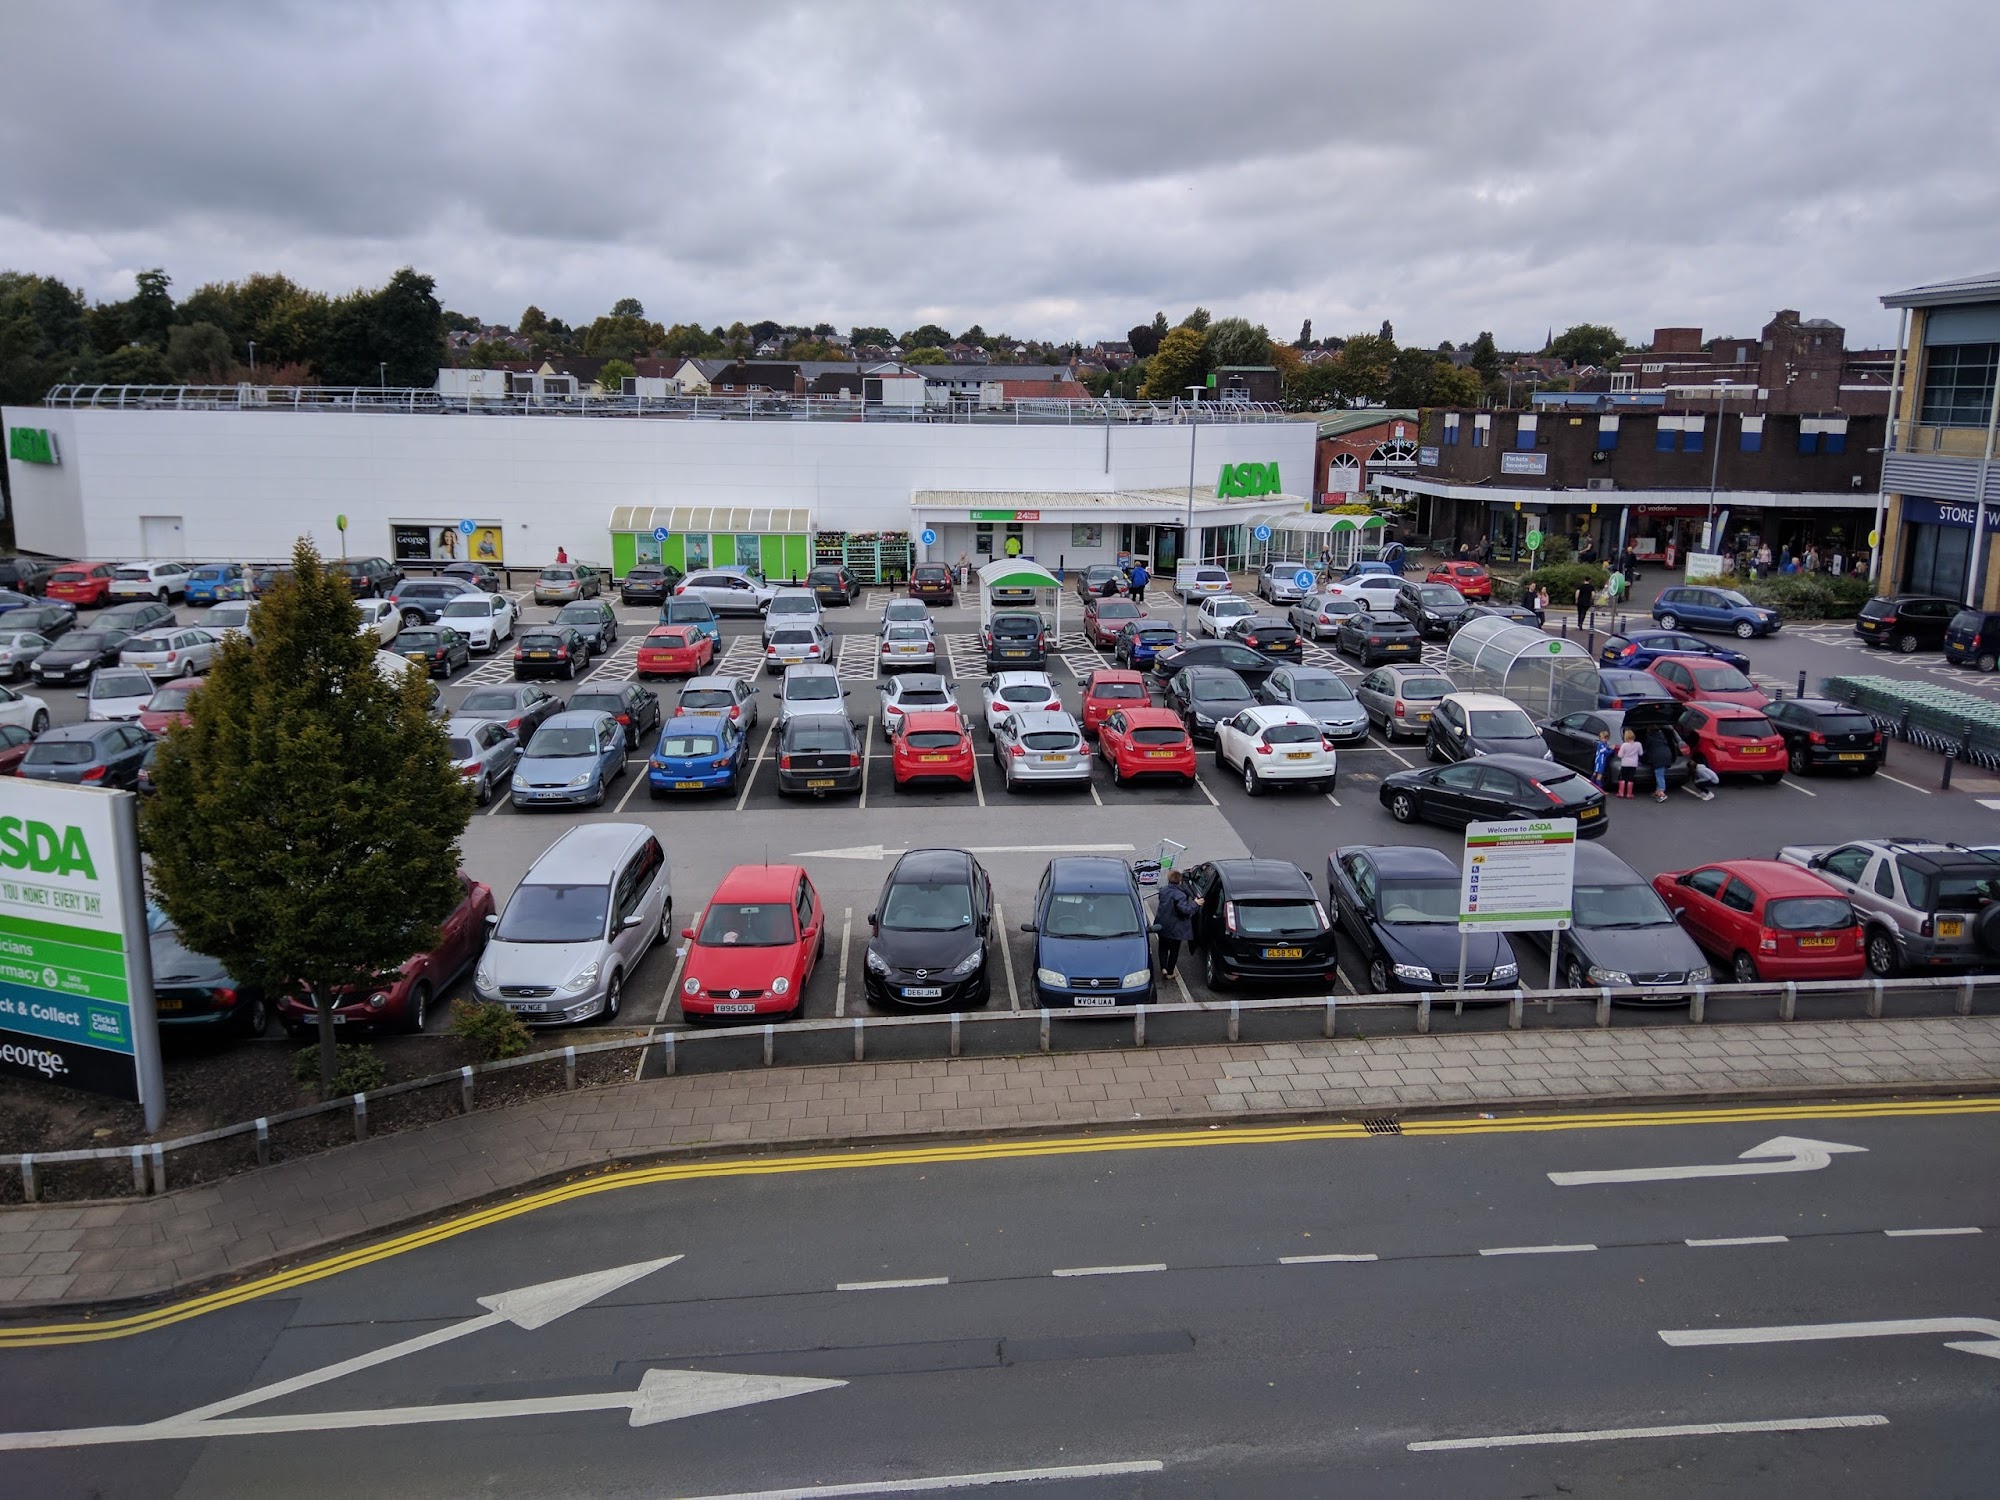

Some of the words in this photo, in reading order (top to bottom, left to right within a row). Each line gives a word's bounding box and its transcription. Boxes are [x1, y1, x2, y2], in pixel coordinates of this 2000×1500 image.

[1217, 462, 1282, 498] ASDA
[1940, 506, 1975, 523] STORE
[1487, 826, 1519, 834] Welcome
[1528, 823, 1552, 831] ASDA
[0, 815, 98, 880] SDA
[2, 883, 19, 900] YOU
[22, 887, 49, 905] MONEY
[53, 891, 80, 910] EVERY
[84, 895, 101, 913] DAY
[1267, 949, 1285, 957] GL58
[0, 964, 39, 983] rmacy
[17, 1001, 28, 1016] &
[30, 1003, 80, 1027] Collect
[92, 1022, 120, 1035] Collect
[0, 1043, 69, 1079] eorge.
